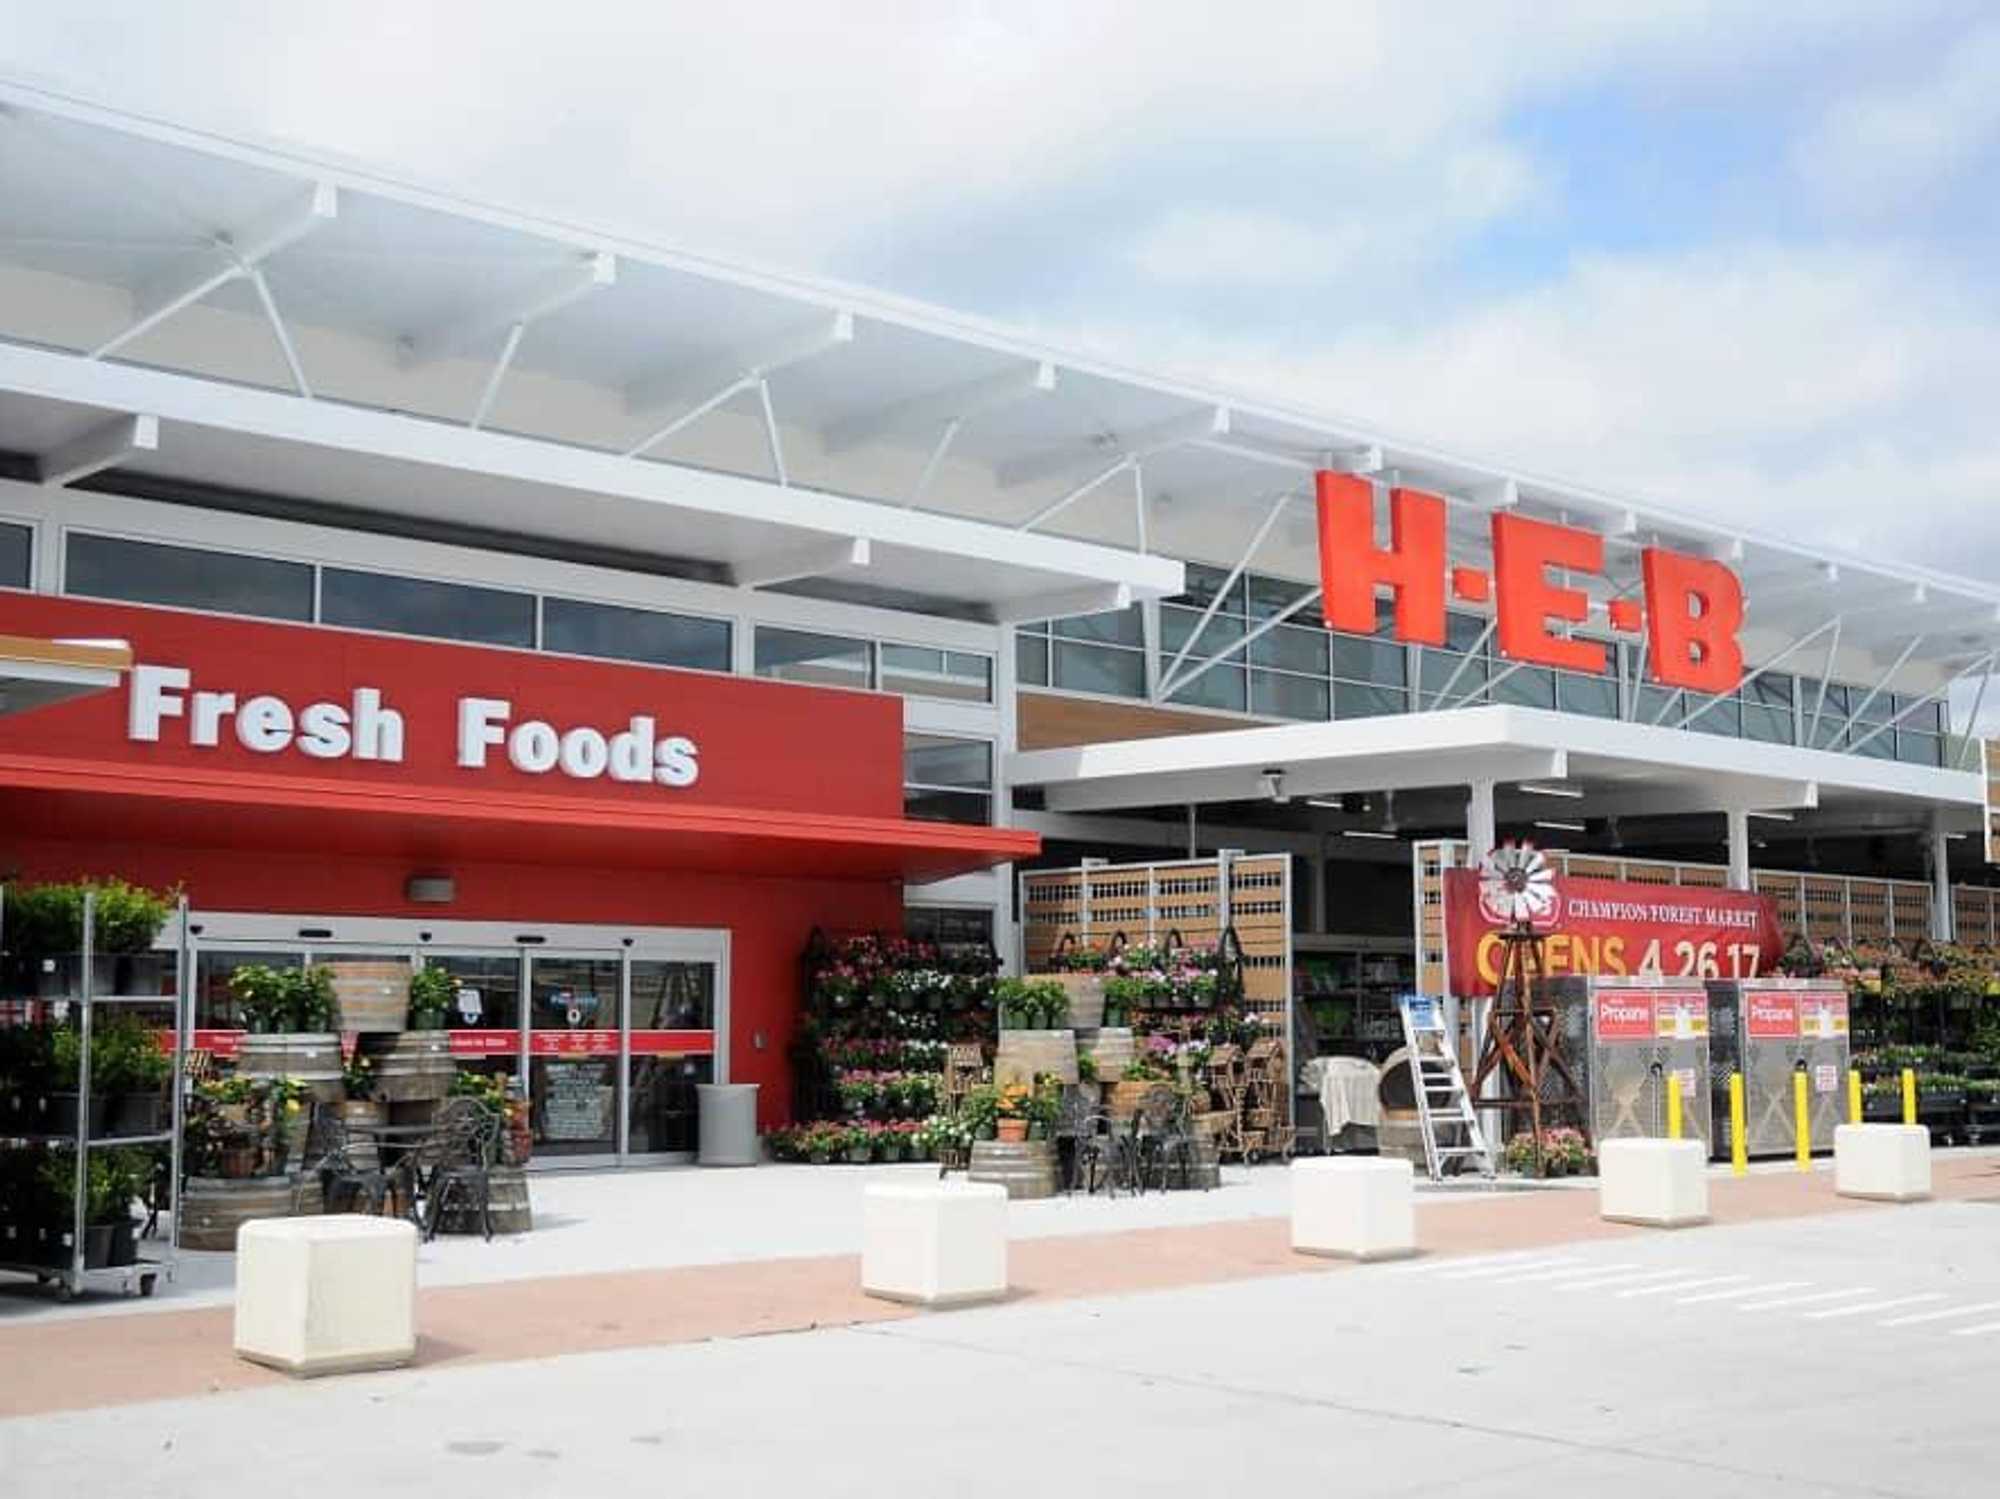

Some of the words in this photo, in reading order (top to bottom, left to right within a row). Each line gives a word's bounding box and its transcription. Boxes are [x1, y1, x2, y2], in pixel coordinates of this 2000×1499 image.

[1316, 470, 1743, 694] H-E-B
[128, 664, 404, 761] Fresh
[457, 697, 699, 786] Foods
[1568, 899, 1647, 922] CHAMPION
[1650, 902, 1702, 925] FOREST
[1704, 905, 1758, 929] MARKET
[1600, 1003, 1648, 1024] Propane
